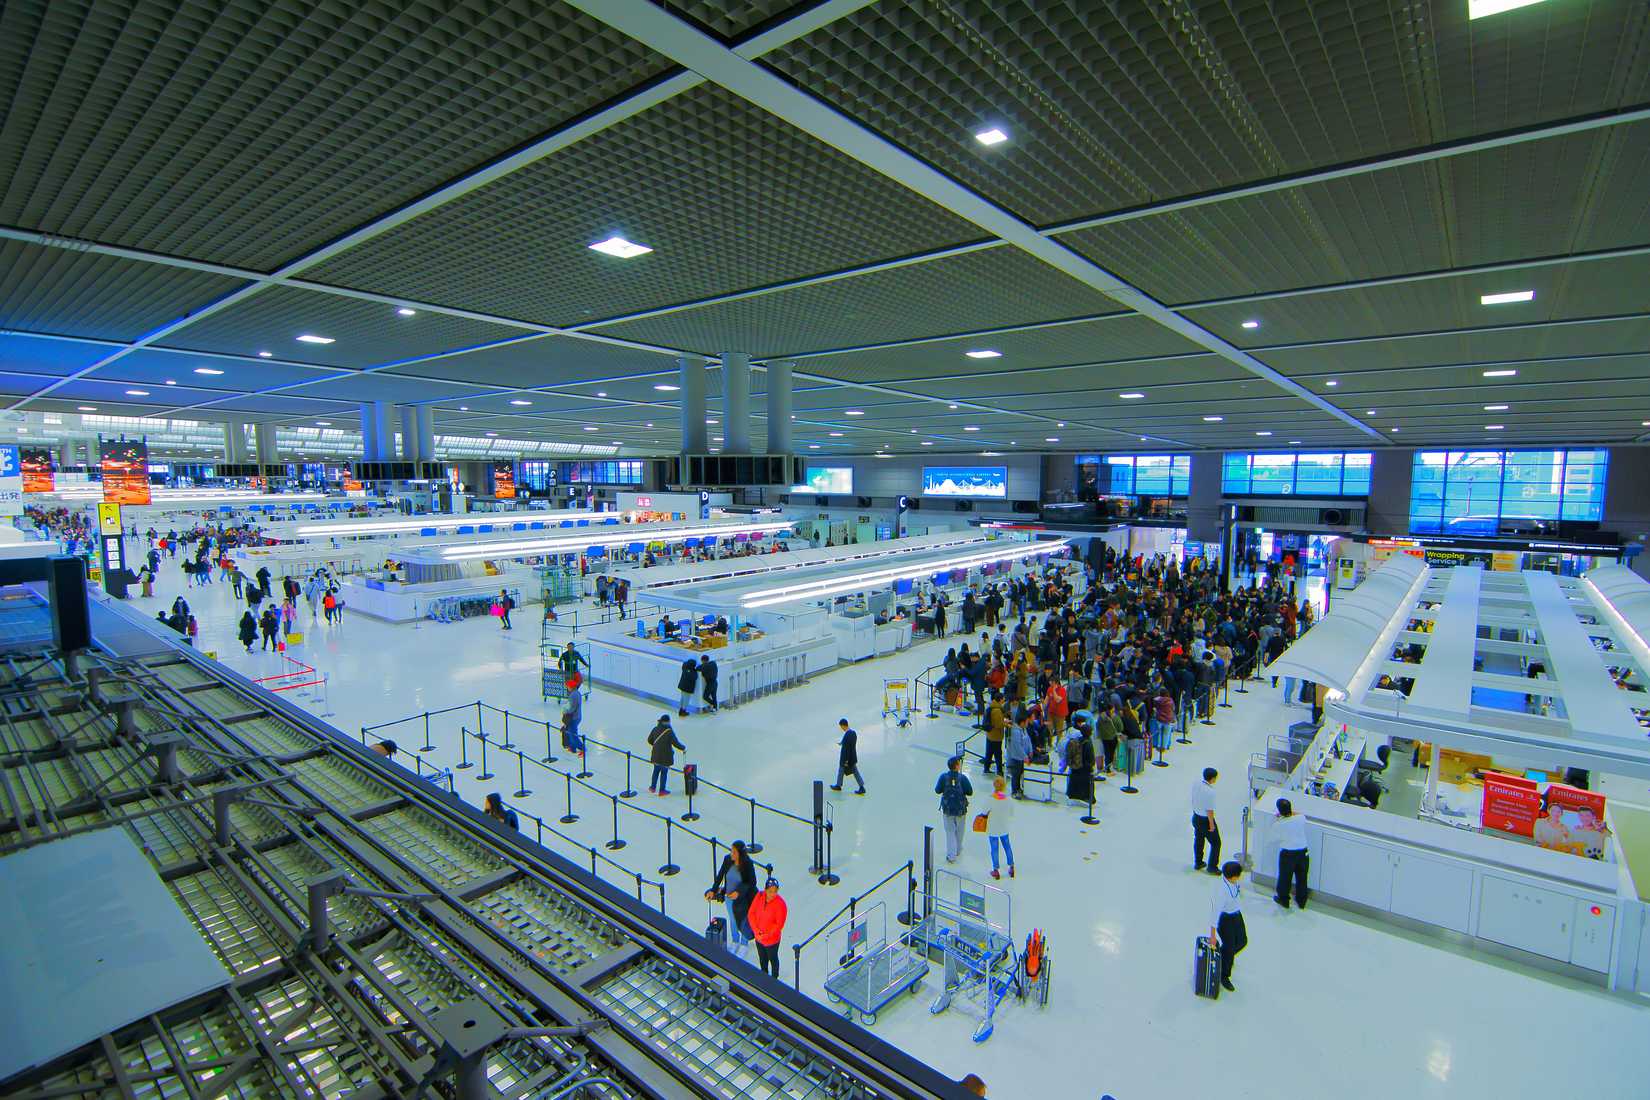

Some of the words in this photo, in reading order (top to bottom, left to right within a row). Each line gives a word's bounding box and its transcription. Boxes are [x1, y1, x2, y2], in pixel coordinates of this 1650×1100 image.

[1426, 551, 1465, 560] Wrapping
[1488, 785, 1525, 799] Emirates
[1551, 789, 1589, 801] Emirates
